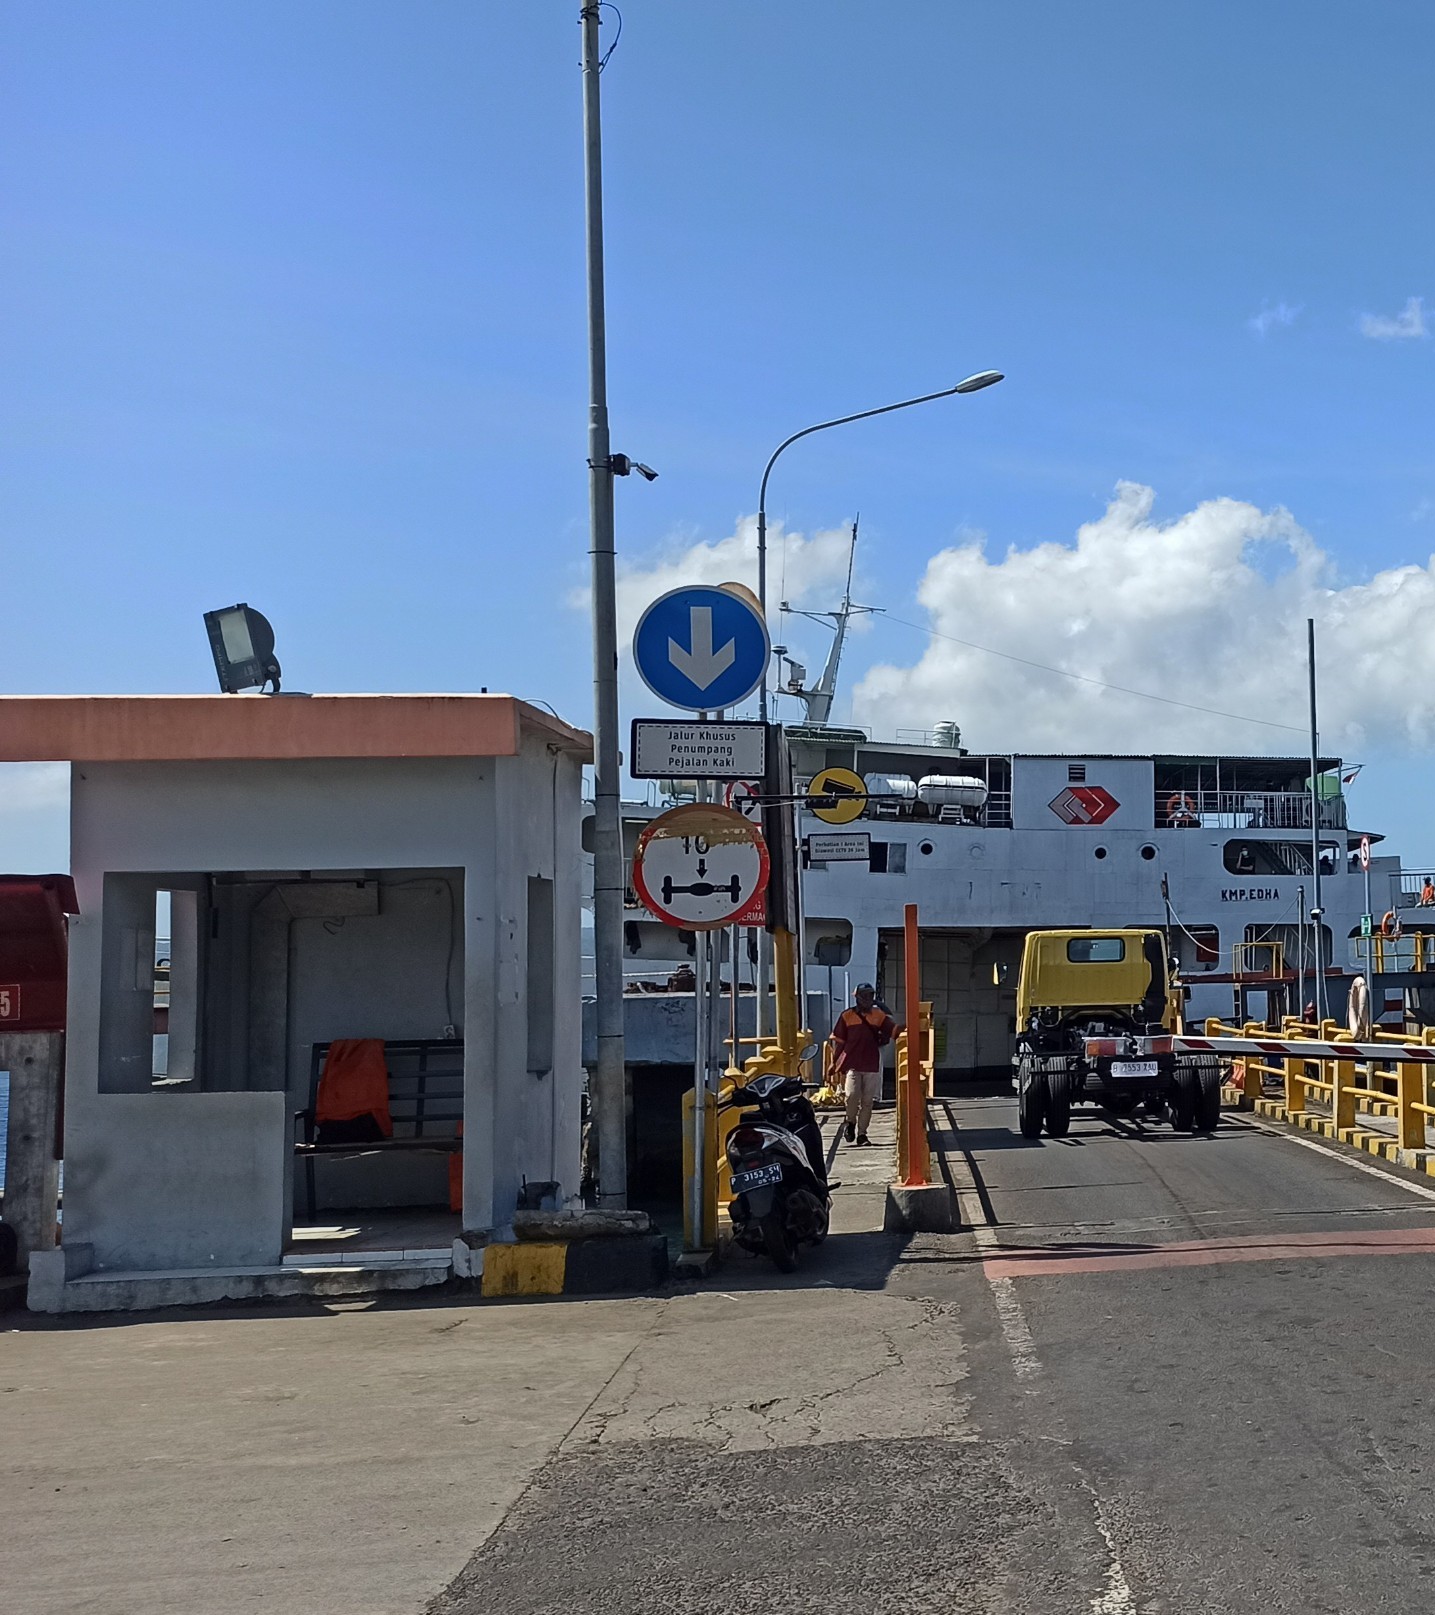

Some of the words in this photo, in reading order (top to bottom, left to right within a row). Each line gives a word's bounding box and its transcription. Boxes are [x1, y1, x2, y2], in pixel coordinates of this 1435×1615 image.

[668, 731, 695, 740] Jalur
[699, 731, 737, 741] Khusus
[671, 744, 733, 757] Penumpang
[668, 757, 708, 769] Pejalan
[712, 757, 735, 767] Kaki
[1221, 888, 1280, 901] KMP.EDHA
[731, 1177, 737, 1186] P
[743, 1170, 764, 1182] 3153
